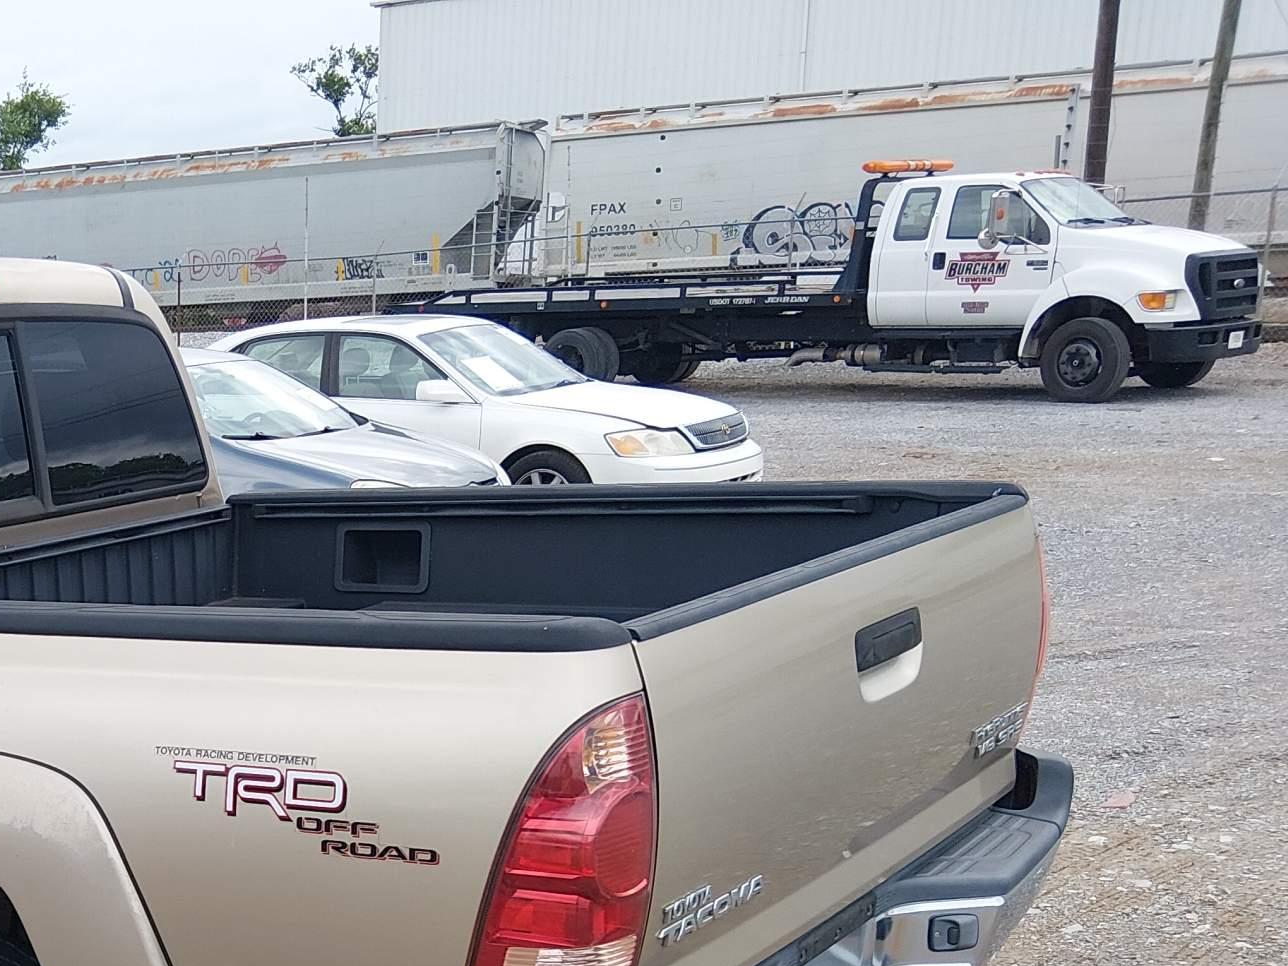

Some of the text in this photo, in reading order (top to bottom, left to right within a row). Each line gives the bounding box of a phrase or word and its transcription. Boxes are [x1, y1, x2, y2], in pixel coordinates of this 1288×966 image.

[590, 202, 626, 216] FPAX
[948, 261, 1008, 278] BURCHAM
[155, 745, 317, 767] TOYOTA RACING DEVELOPMENT
[173, 760, 348, 822] TRD
[295, 816, 380, 838] OFF
[320, 839, 441, 865] ROAD
[655, 873, 764, 947] TACOMA
[662, 884, 712, 923] TOYOTA
